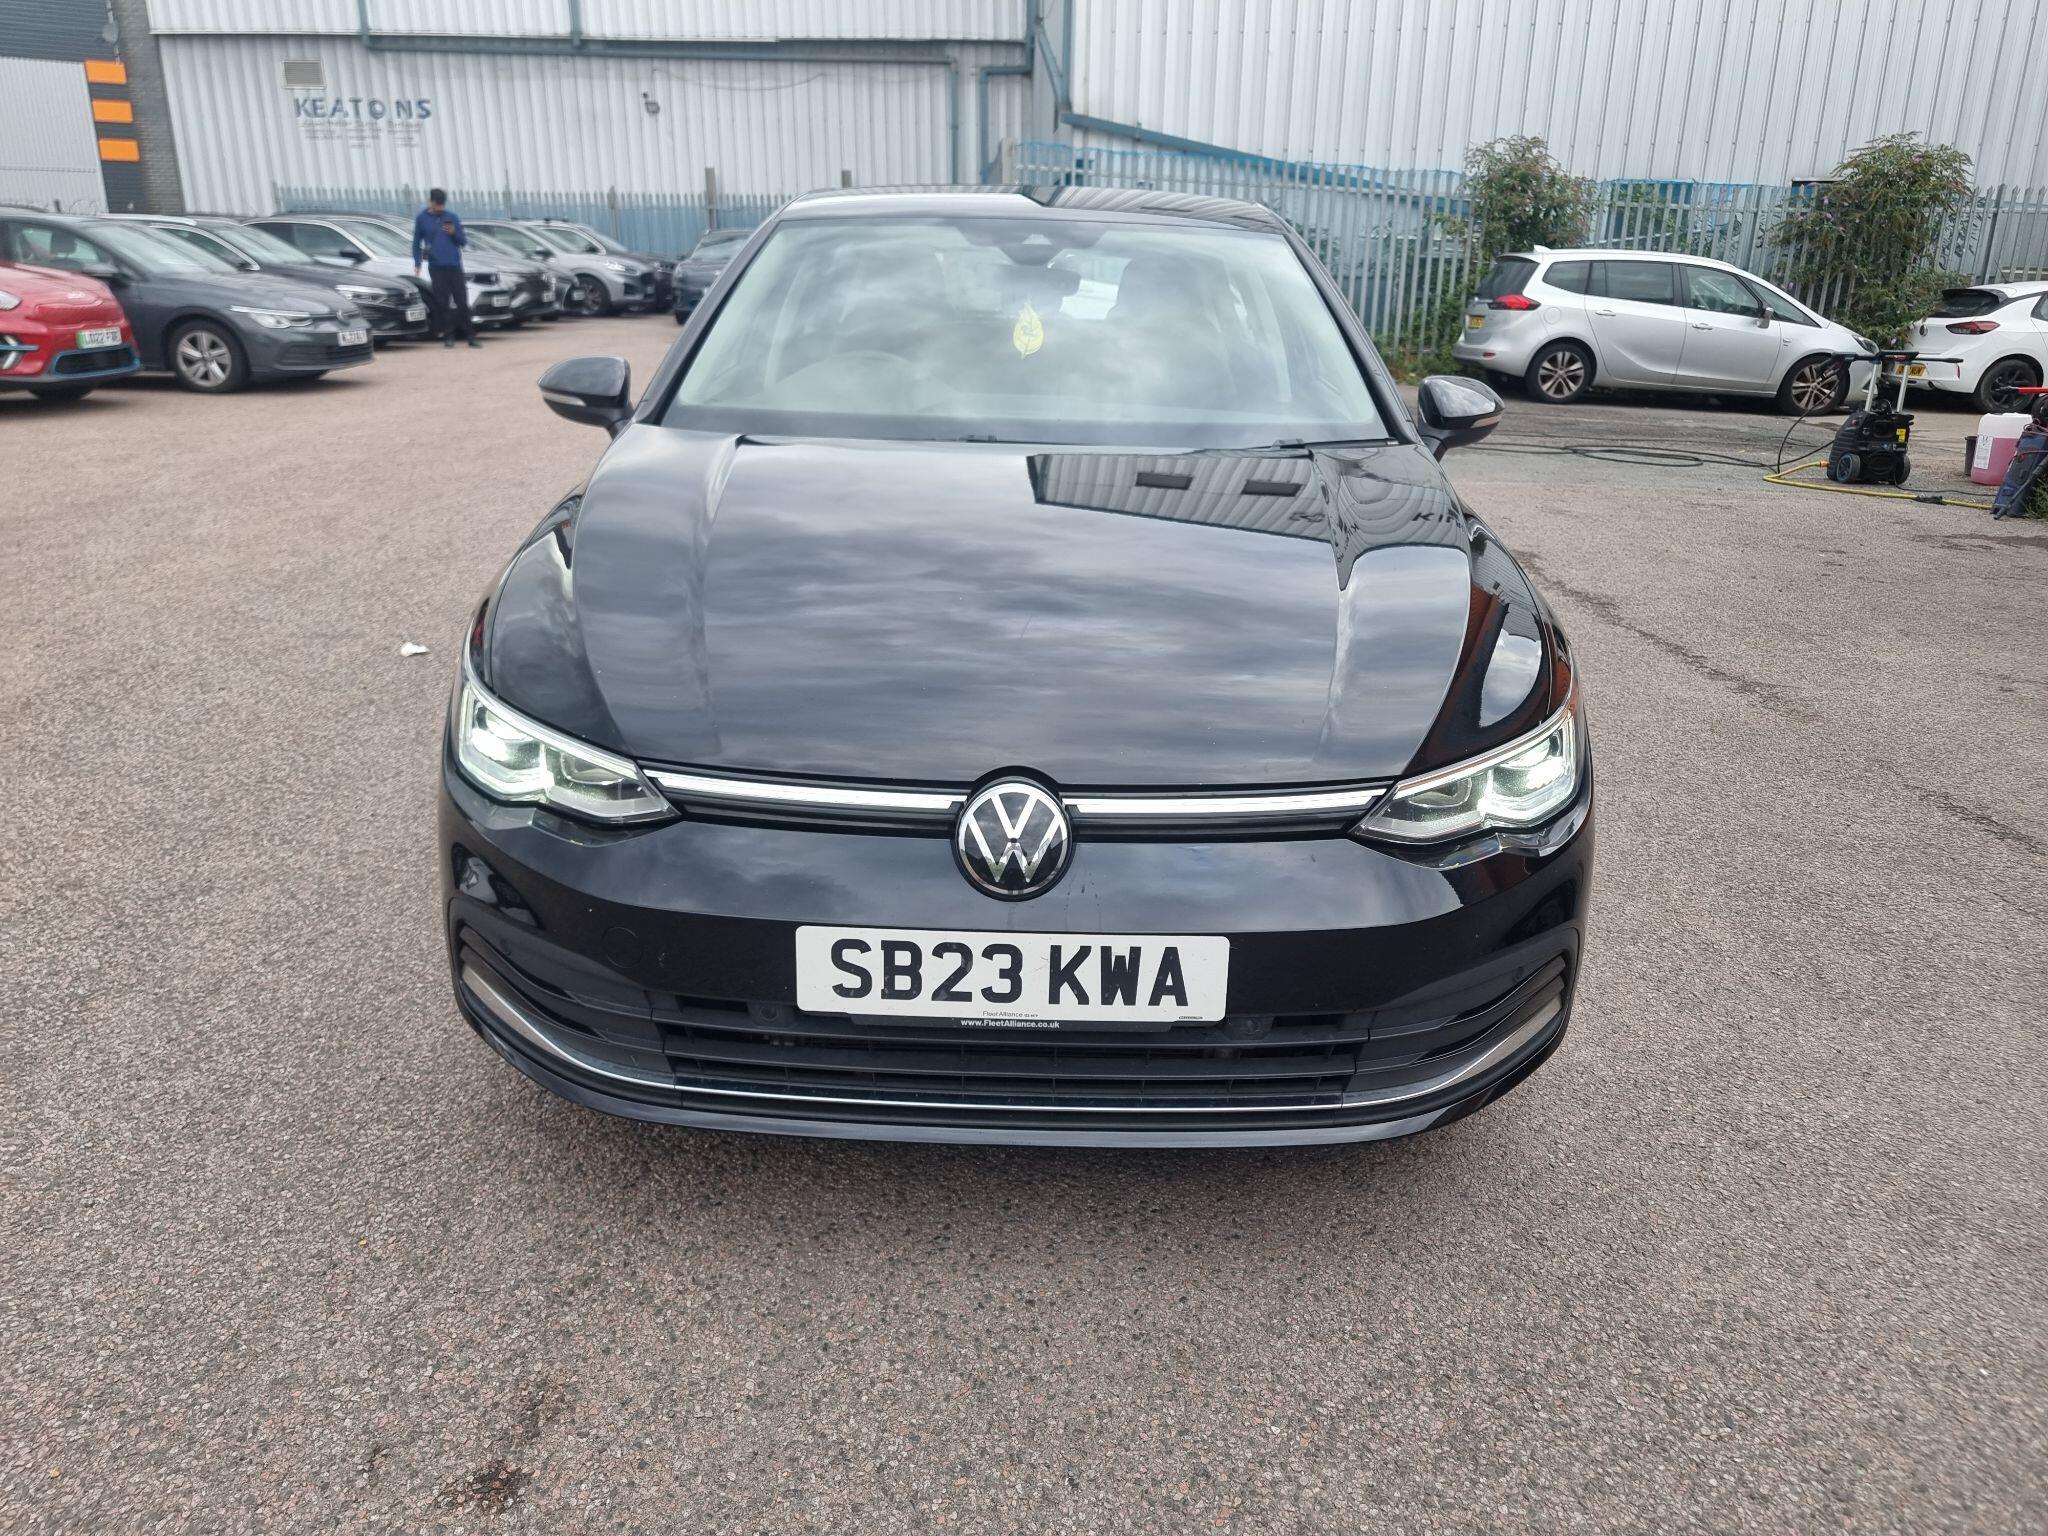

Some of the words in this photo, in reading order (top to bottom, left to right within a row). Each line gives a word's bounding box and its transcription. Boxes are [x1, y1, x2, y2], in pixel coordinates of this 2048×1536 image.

[293, 97, 432, 119] KEATONS
[830, 938, 1023, 1003] SB23
[1048, 945, 1189, 1007] KWA
[960, 1019, 1060, 1028] www.FleetAlliance.co.uk
